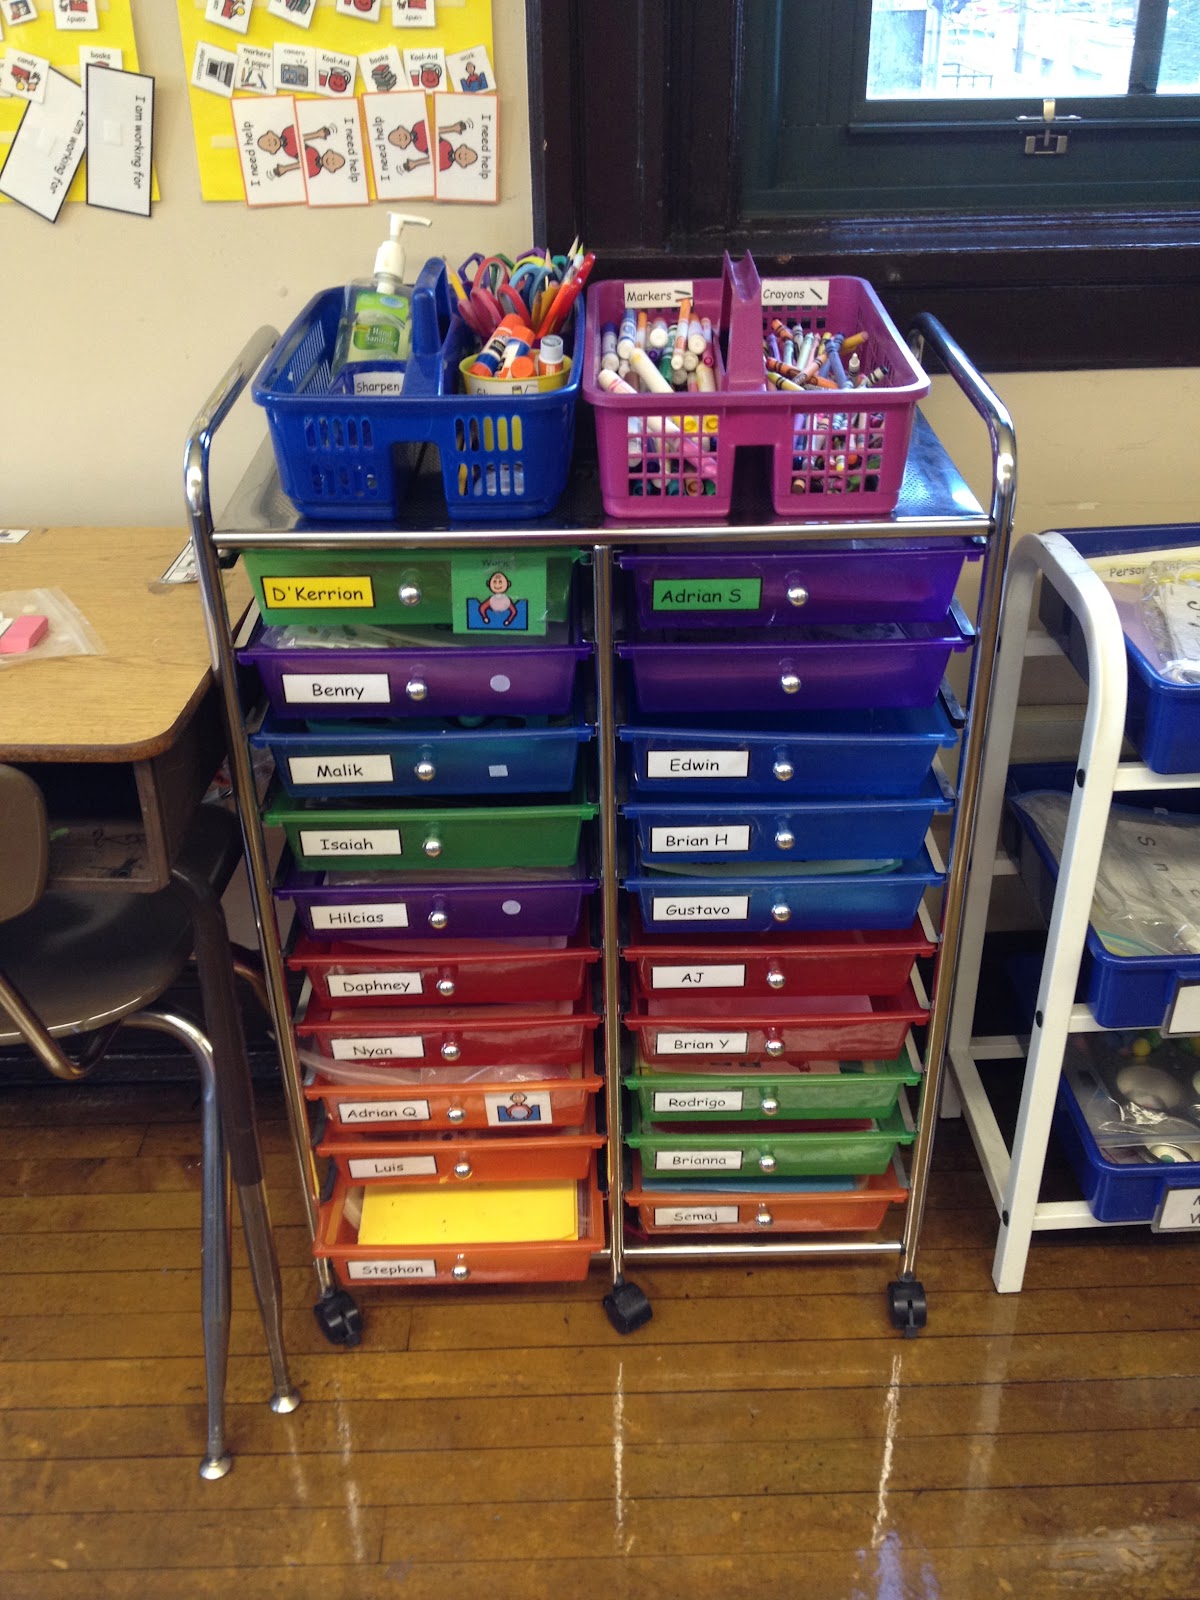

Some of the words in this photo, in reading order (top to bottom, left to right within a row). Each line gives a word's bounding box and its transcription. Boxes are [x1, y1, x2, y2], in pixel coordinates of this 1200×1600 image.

[90, 51, 111, 60] books
[243, 47, 271, 58] markers
[369, 54, 388, 64] books
[17, 56, 37, 68] candy
[322, 54, 350, 67] Kool-Aid
[135, 95, 146, 103] I
[135, 105, 143, 121] am
[481, 113, 492, 121] I
[241, 121, 254, 146] help
[372, 116, 385, 141] help
[345, 128, 356, 156] need
[481, 124, 492, 153] need
[131, 125, 145, 168] working
[54, 136, 77, 175] working
[376, 144, 389, 171] need
[248, 149, 259, 177] need
[478, 155, 492, 179] help
[348, 158, 360, 183] help
[49, 176, 63, 194] for
[133, 171, 145, 189] for
[626, 290, 672, 302] Markers
[762, 289, 805, 301] Crayons
[372, 327, 393, 338] Hand
[356, 382, 400, 394] Sharpen
[272, 586, 364, 601] D'Kerrion
[661, 589, 722, 604] Adrian
[728, 588, 742, 602] S
[312, 683, 364, 700] Benny
[316, 764, 364, 778] Malik
[669, 758, 720, 772] Edwin
[320, 838, 374, 851] Isaiah
[666, 834, 709, 847] Brian
[715, 834, 728, 845] H
[666, 904, 730, 916] Gustavo
[329, 912, 384, 924] Hilcias
[681, 972, 704, 983] AJ
[343, 979, 411, 994] Daphney
[674, 1039, 714, 1050] Brian
[719, 1038, 730, 1049] Y
[353, 1045, 393, 1058] Nyan
[669, 1097, 726, 1110] Rodrigo
[348, 1107, 398, 1118] Adrian
[402, 1106, 418, 1119] Q
[672, 1155, 727, 1166] Brianna
[374, 1163, 404, 1173] Luis
[674, 1211, 718, 1222] Semaj
[362, 1264, 424, 1277] Stephon
